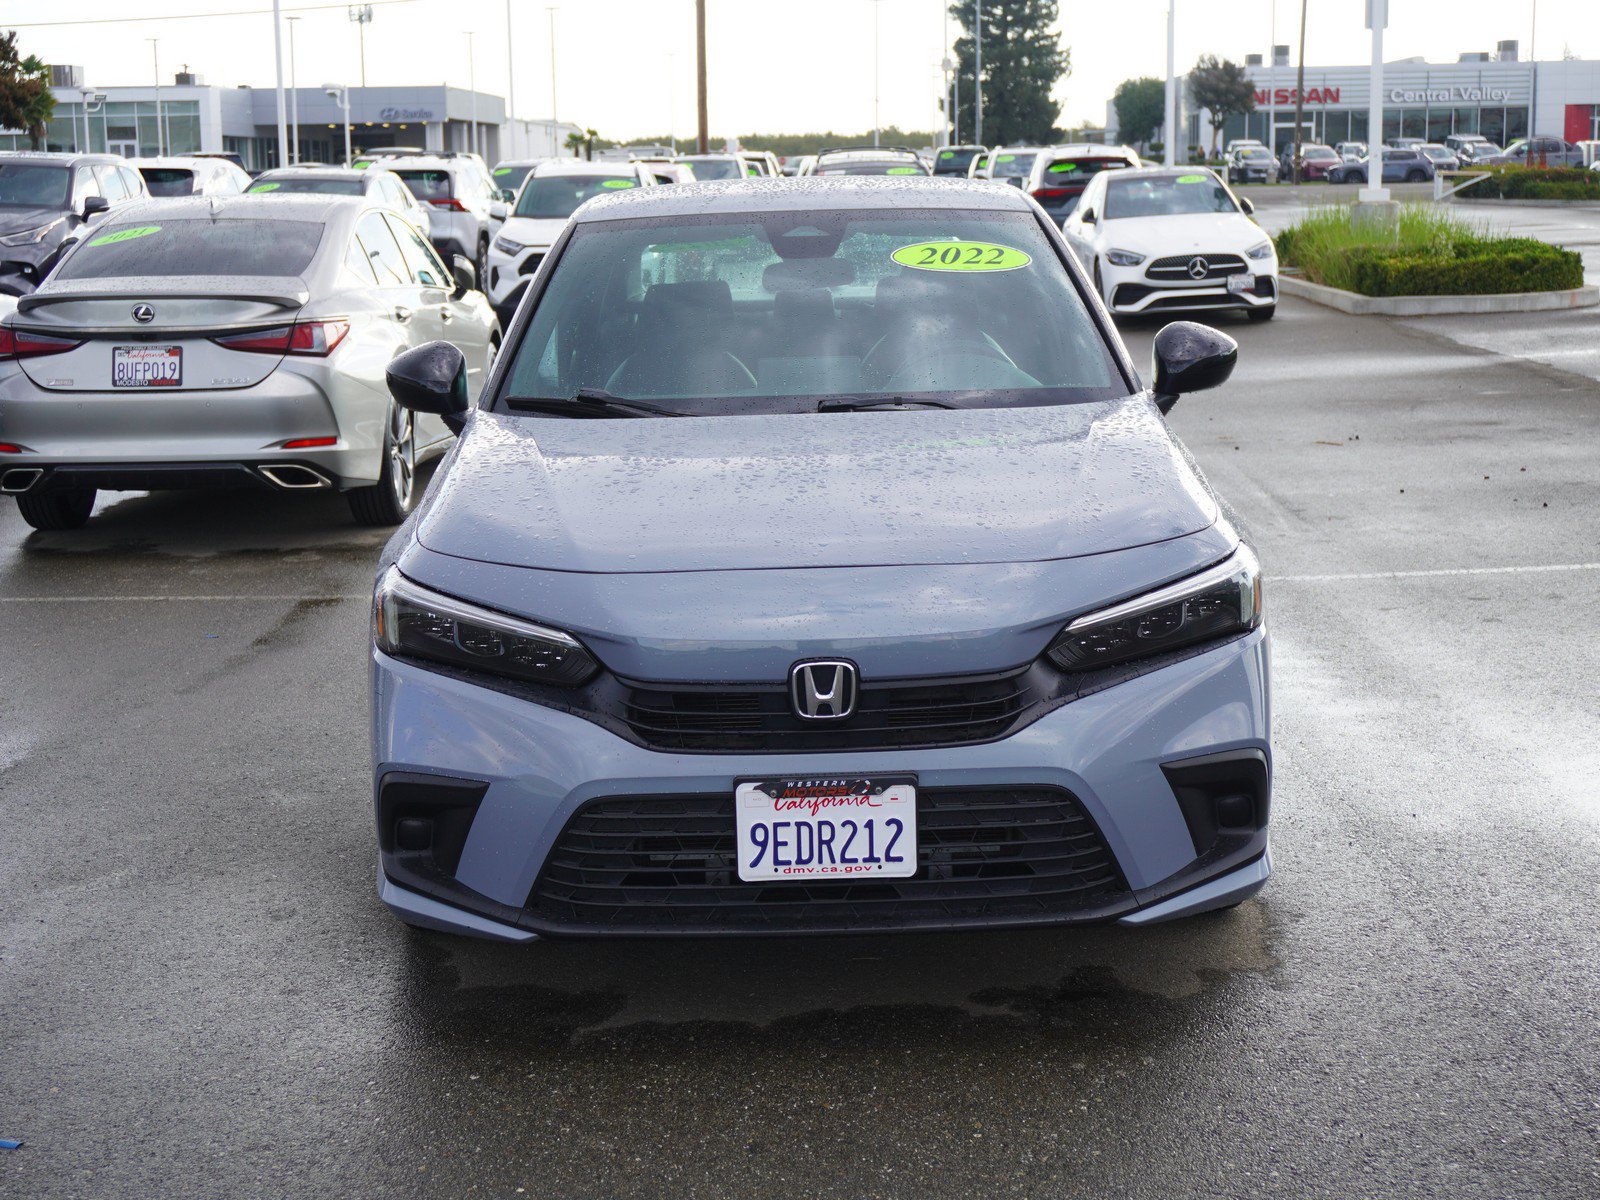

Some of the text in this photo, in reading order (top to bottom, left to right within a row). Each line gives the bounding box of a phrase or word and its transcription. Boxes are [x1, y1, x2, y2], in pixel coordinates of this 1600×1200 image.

[1251, 87, 1340, 105] NISSAN
[1390, 86, 1511, 103] Central Valley
[916, 246, 1006, 265] 2022
[117, 362, 177, 380] 8UFP019
[116, 379, 149, 387] MODESTO
[781, 785, 848, 798] MOTORS
[786, 780, 847, 788] WESTERN
[773, 795, 883, 817] California
[749, 817, 904, 869] 9EDR212
[782, 864, 873, 875] dmv.ca.gov
